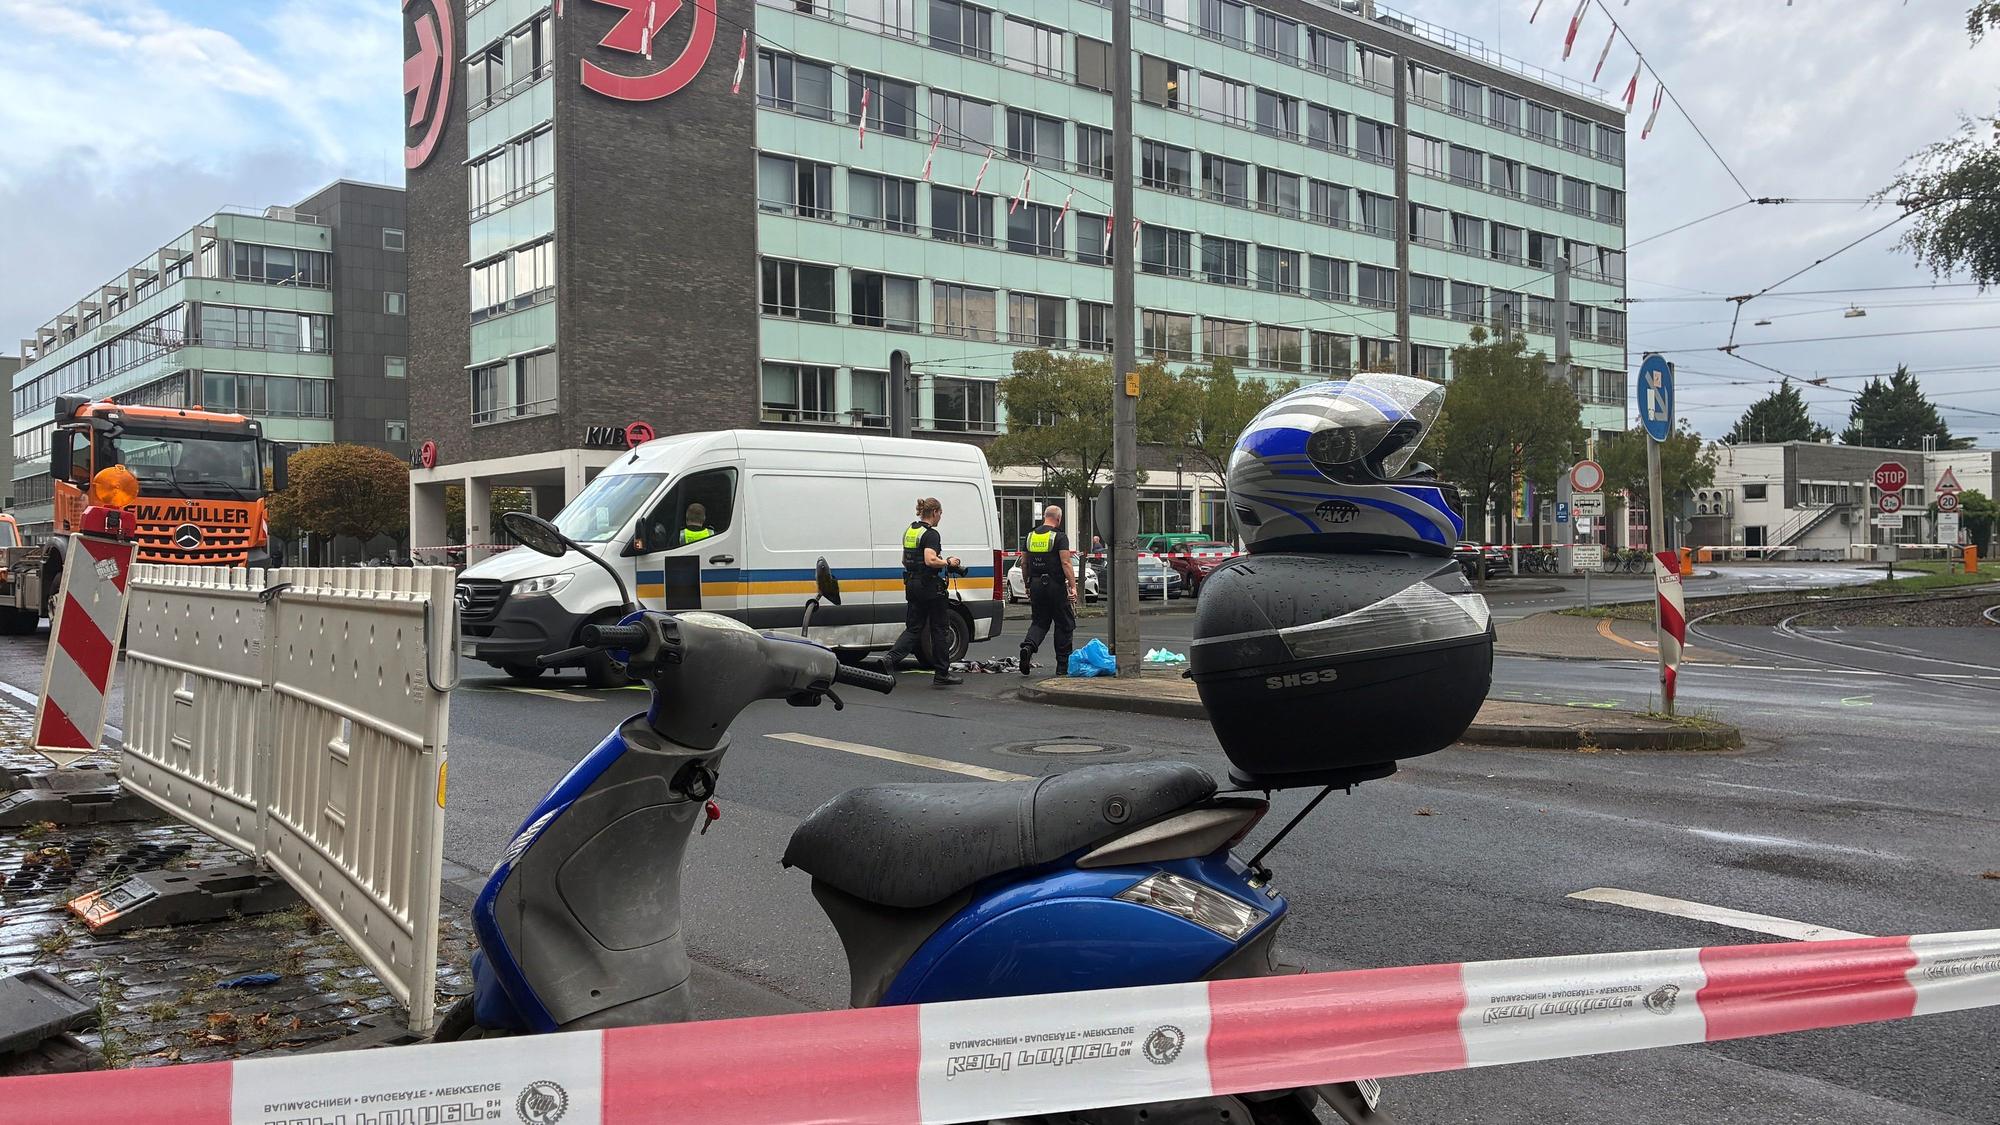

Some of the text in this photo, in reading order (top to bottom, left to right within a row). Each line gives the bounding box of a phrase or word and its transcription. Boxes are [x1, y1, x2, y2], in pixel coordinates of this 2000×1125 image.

[1854, 418, 1863, 429] 90
[584, 426, 626, 445] KVB
[1877, 471, 1904, 484] STOP
[1559, 503, 1565, 511] P
[1943, 498, 1954, 507] 20
[1264, 669, 1338, 689] SH33
